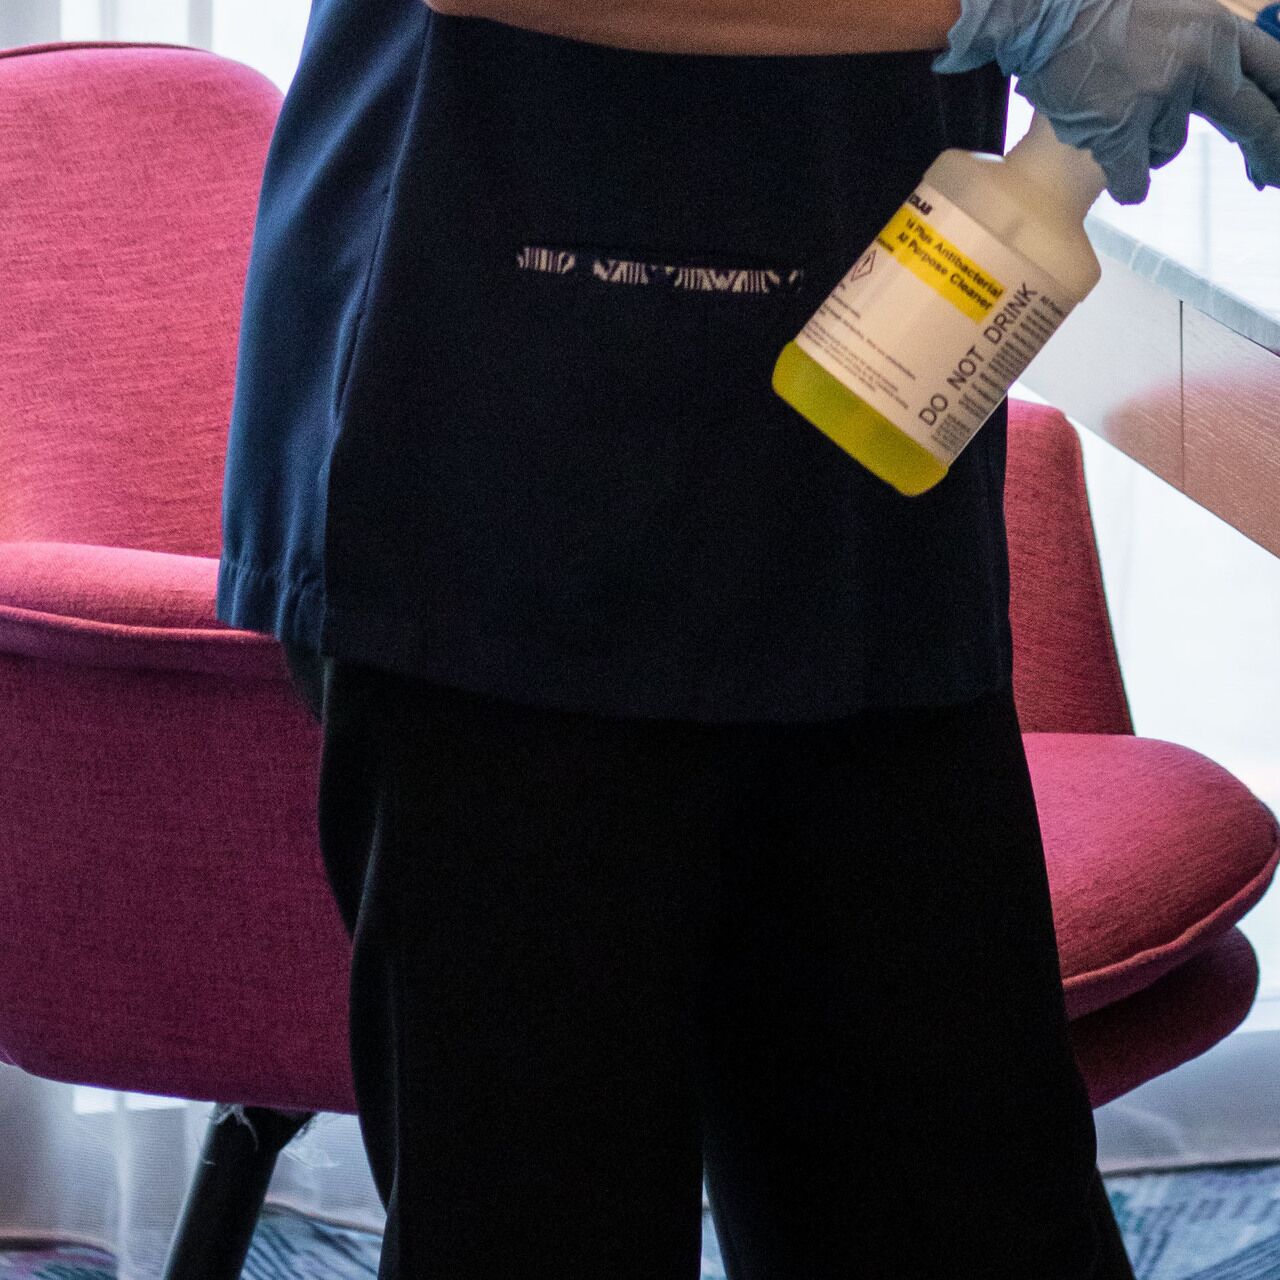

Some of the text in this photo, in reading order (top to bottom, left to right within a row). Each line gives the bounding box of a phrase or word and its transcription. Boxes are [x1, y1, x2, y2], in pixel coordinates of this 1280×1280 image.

[908, 238, 948, 276] Purpose
[950, 272, 993, 311] Cleaner
[934, 242, 1004, 298] Antibacterial
[918, 392, 949, 427] DO
[946, 344, 985, 391] NOT
[983, 281, 1039, 344] DRINK
